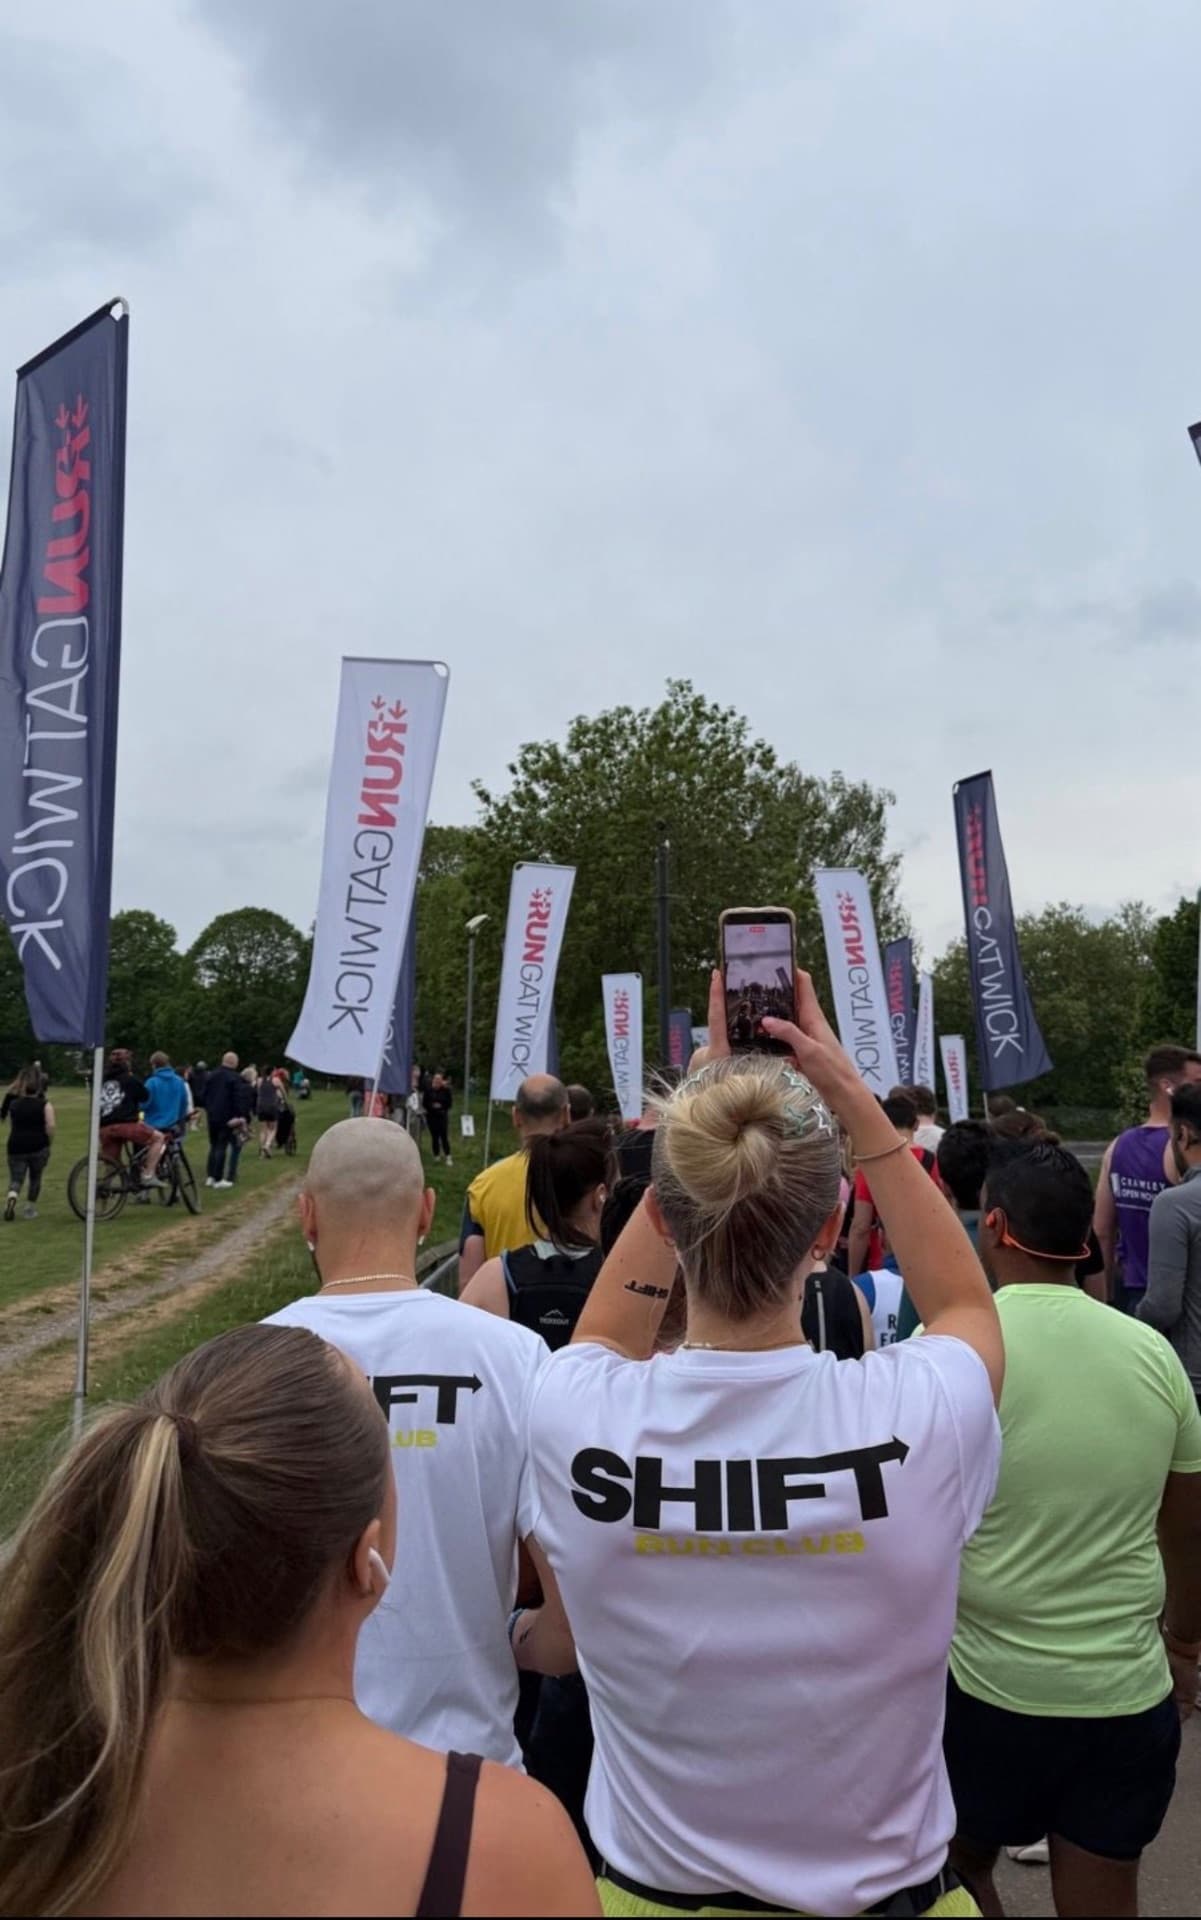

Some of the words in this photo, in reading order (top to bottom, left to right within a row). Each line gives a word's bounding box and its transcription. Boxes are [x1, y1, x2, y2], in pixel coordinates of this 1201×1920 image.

[509, 900, 551, 1077] RUNGATWICK
[571, 1435, 910, 1532] SHIFT
[634, 1534, 731, 1556] RUN
[742, 1531, 866, 1556] CLUB
